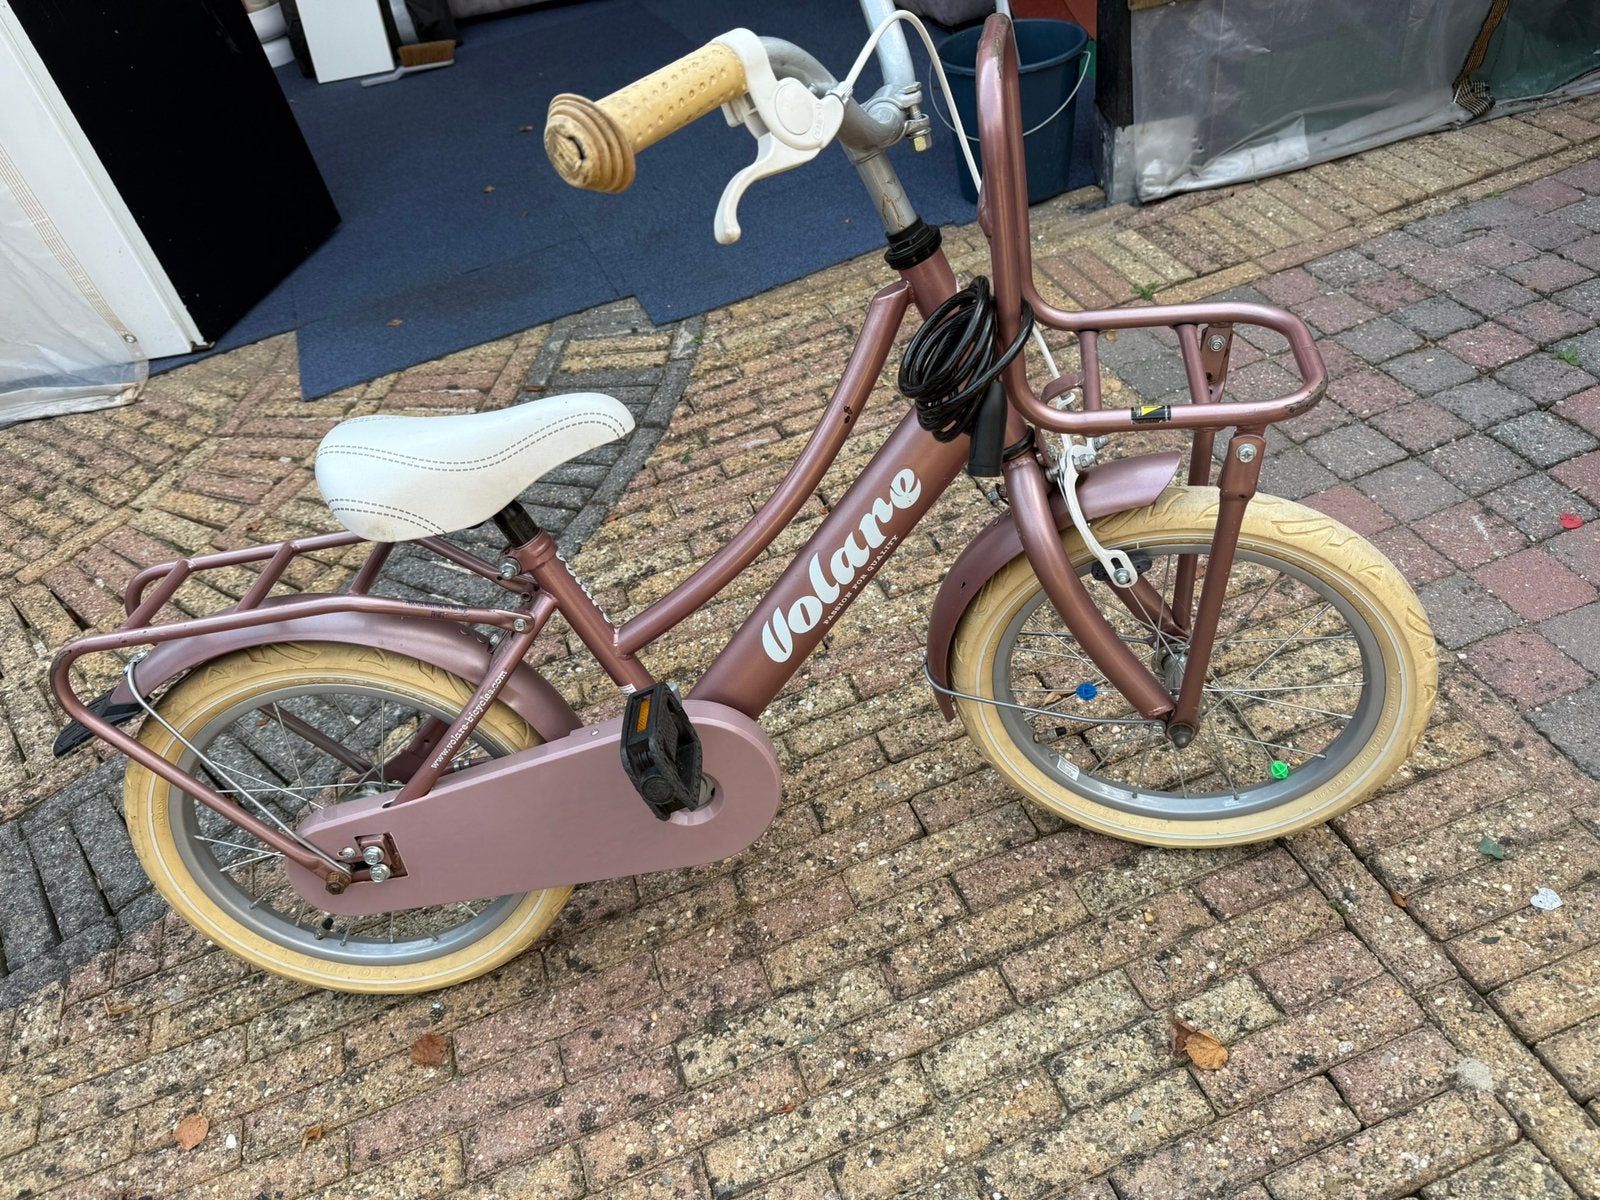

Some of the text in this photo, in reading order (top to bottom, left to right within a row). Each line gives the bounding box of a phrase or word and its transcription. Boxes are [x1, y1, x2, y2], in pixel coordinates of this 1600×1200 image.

[823, 534, 899, 625] PASSION FOR QUALITY
[430, 669, 508, 770] www.volare-bicycles.com
